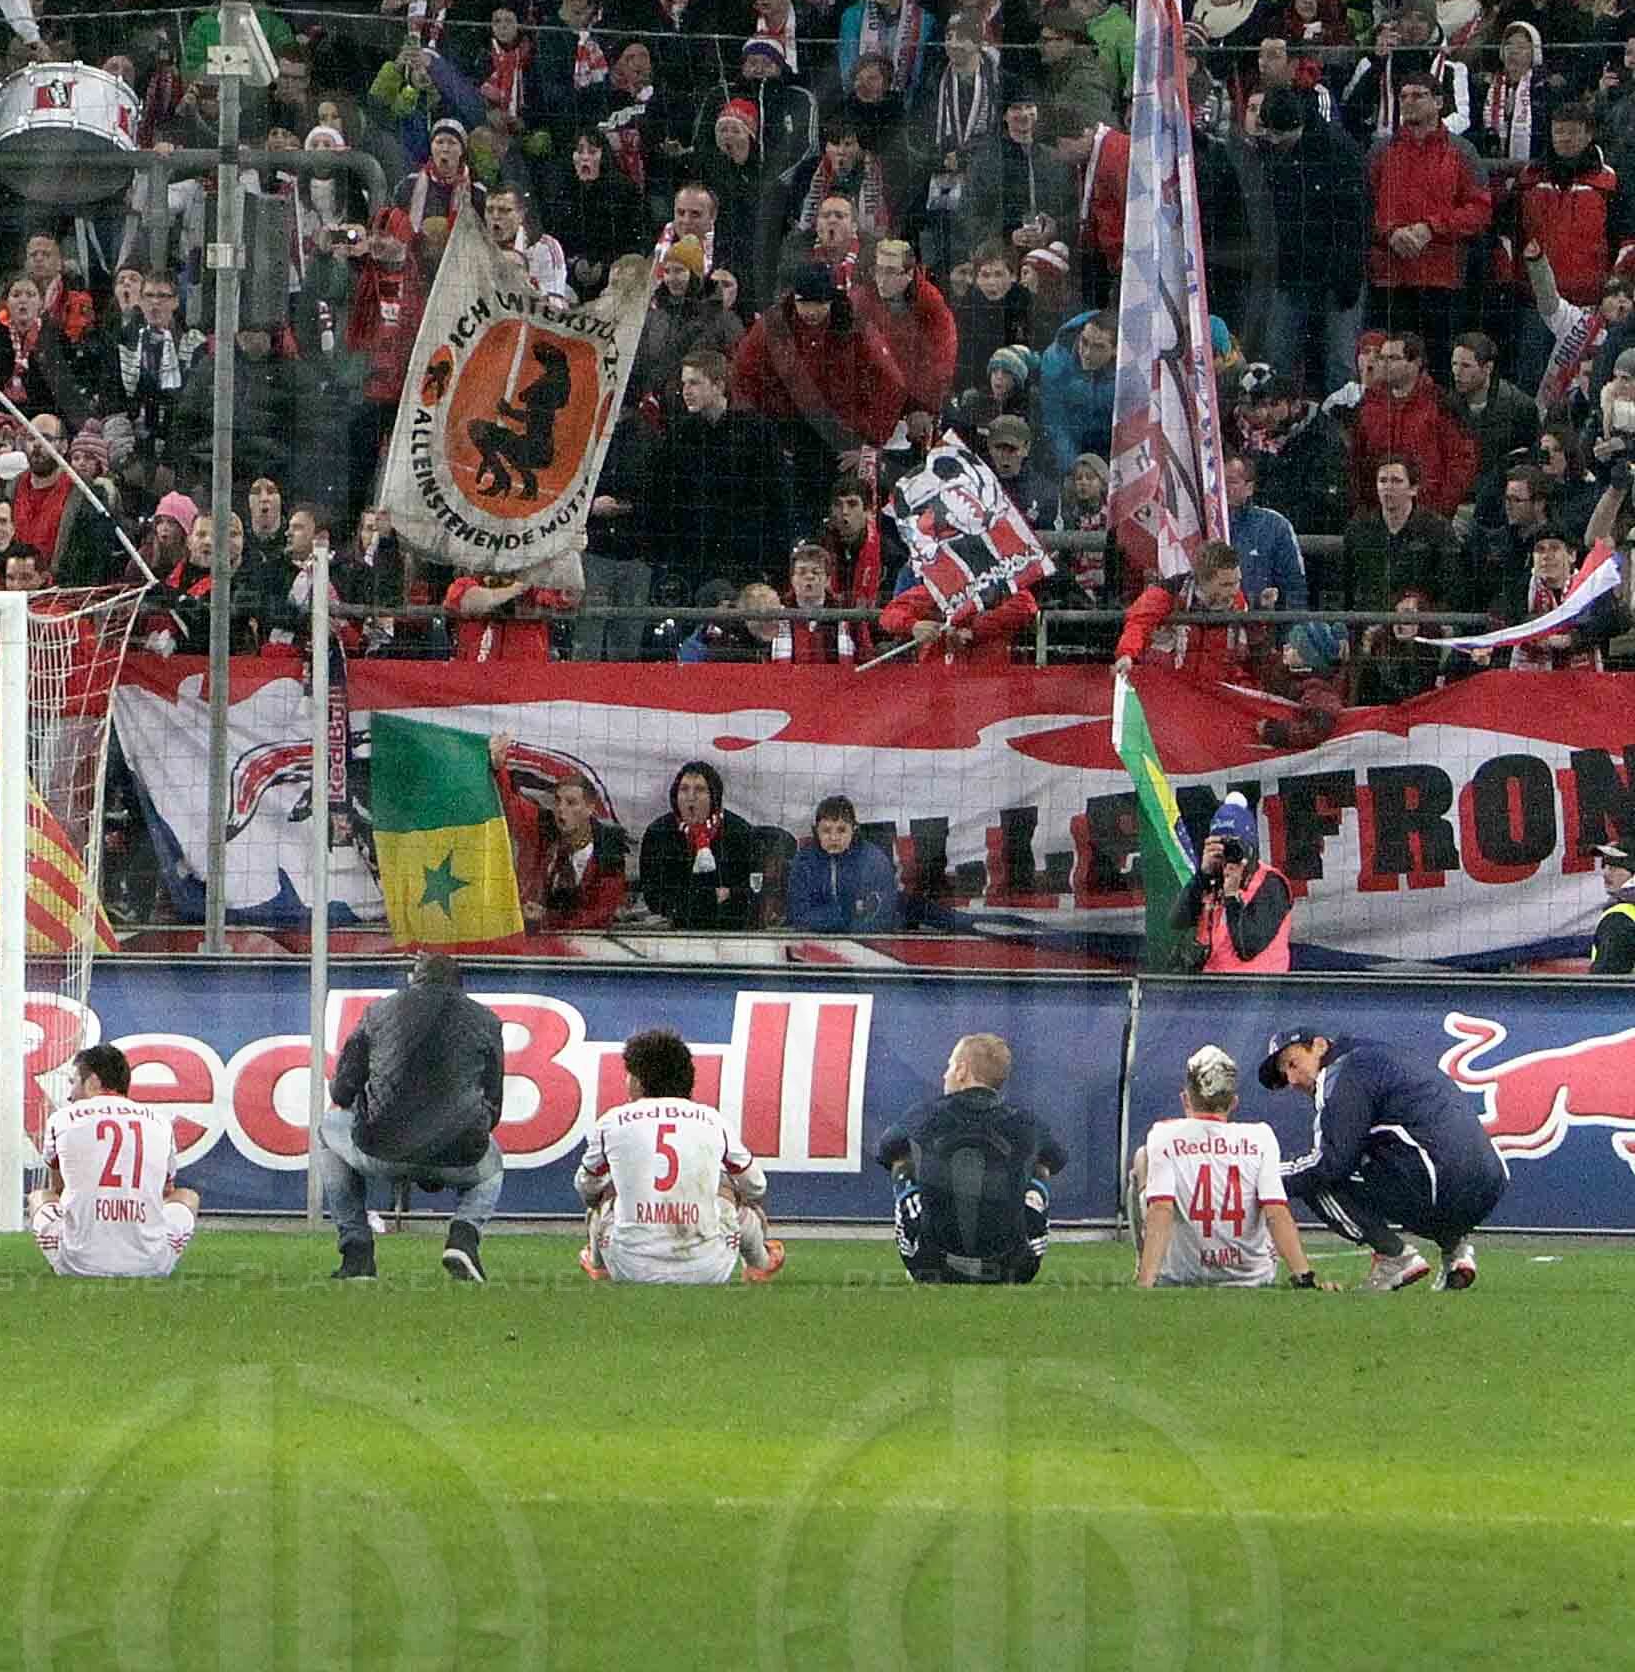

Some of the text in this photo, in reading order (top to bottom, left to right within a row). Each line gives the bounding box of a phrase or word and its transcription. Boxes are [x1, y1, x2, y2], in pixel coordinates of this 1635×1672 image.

[95, 1118, 145, 1190] 21
[652, 1123, 681, 1193] 5
[94, 1198, 147, 1224] FOUNTAS
[635, 1199, 700, 1227] RAMALHO
[1188, 1163, 1247, 1240] 44
